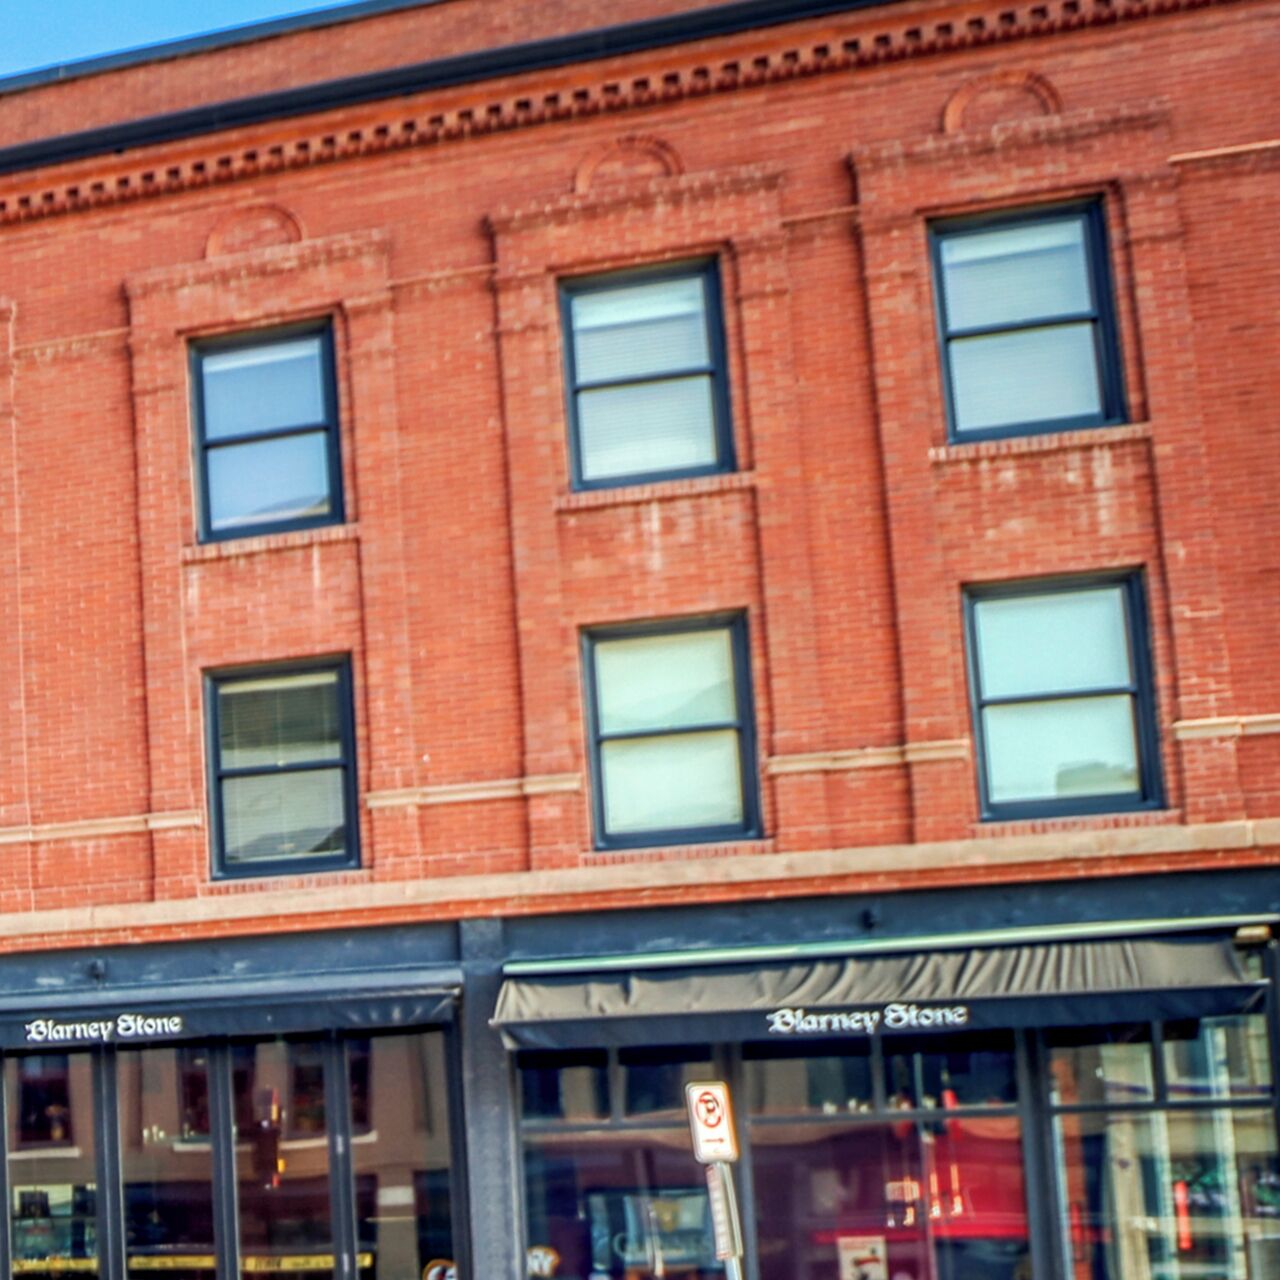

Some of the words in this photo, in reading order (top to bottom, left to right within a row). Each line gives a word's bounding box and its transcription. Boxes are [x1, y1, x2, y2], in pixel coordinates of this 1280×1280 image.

[25, 1018, 114, 1042] Blarney
[116, 1013, 183, 1037] Stone
[765, 1008, 881, 1035] Blarney
[883, 1003, 969, 1029] Stone
